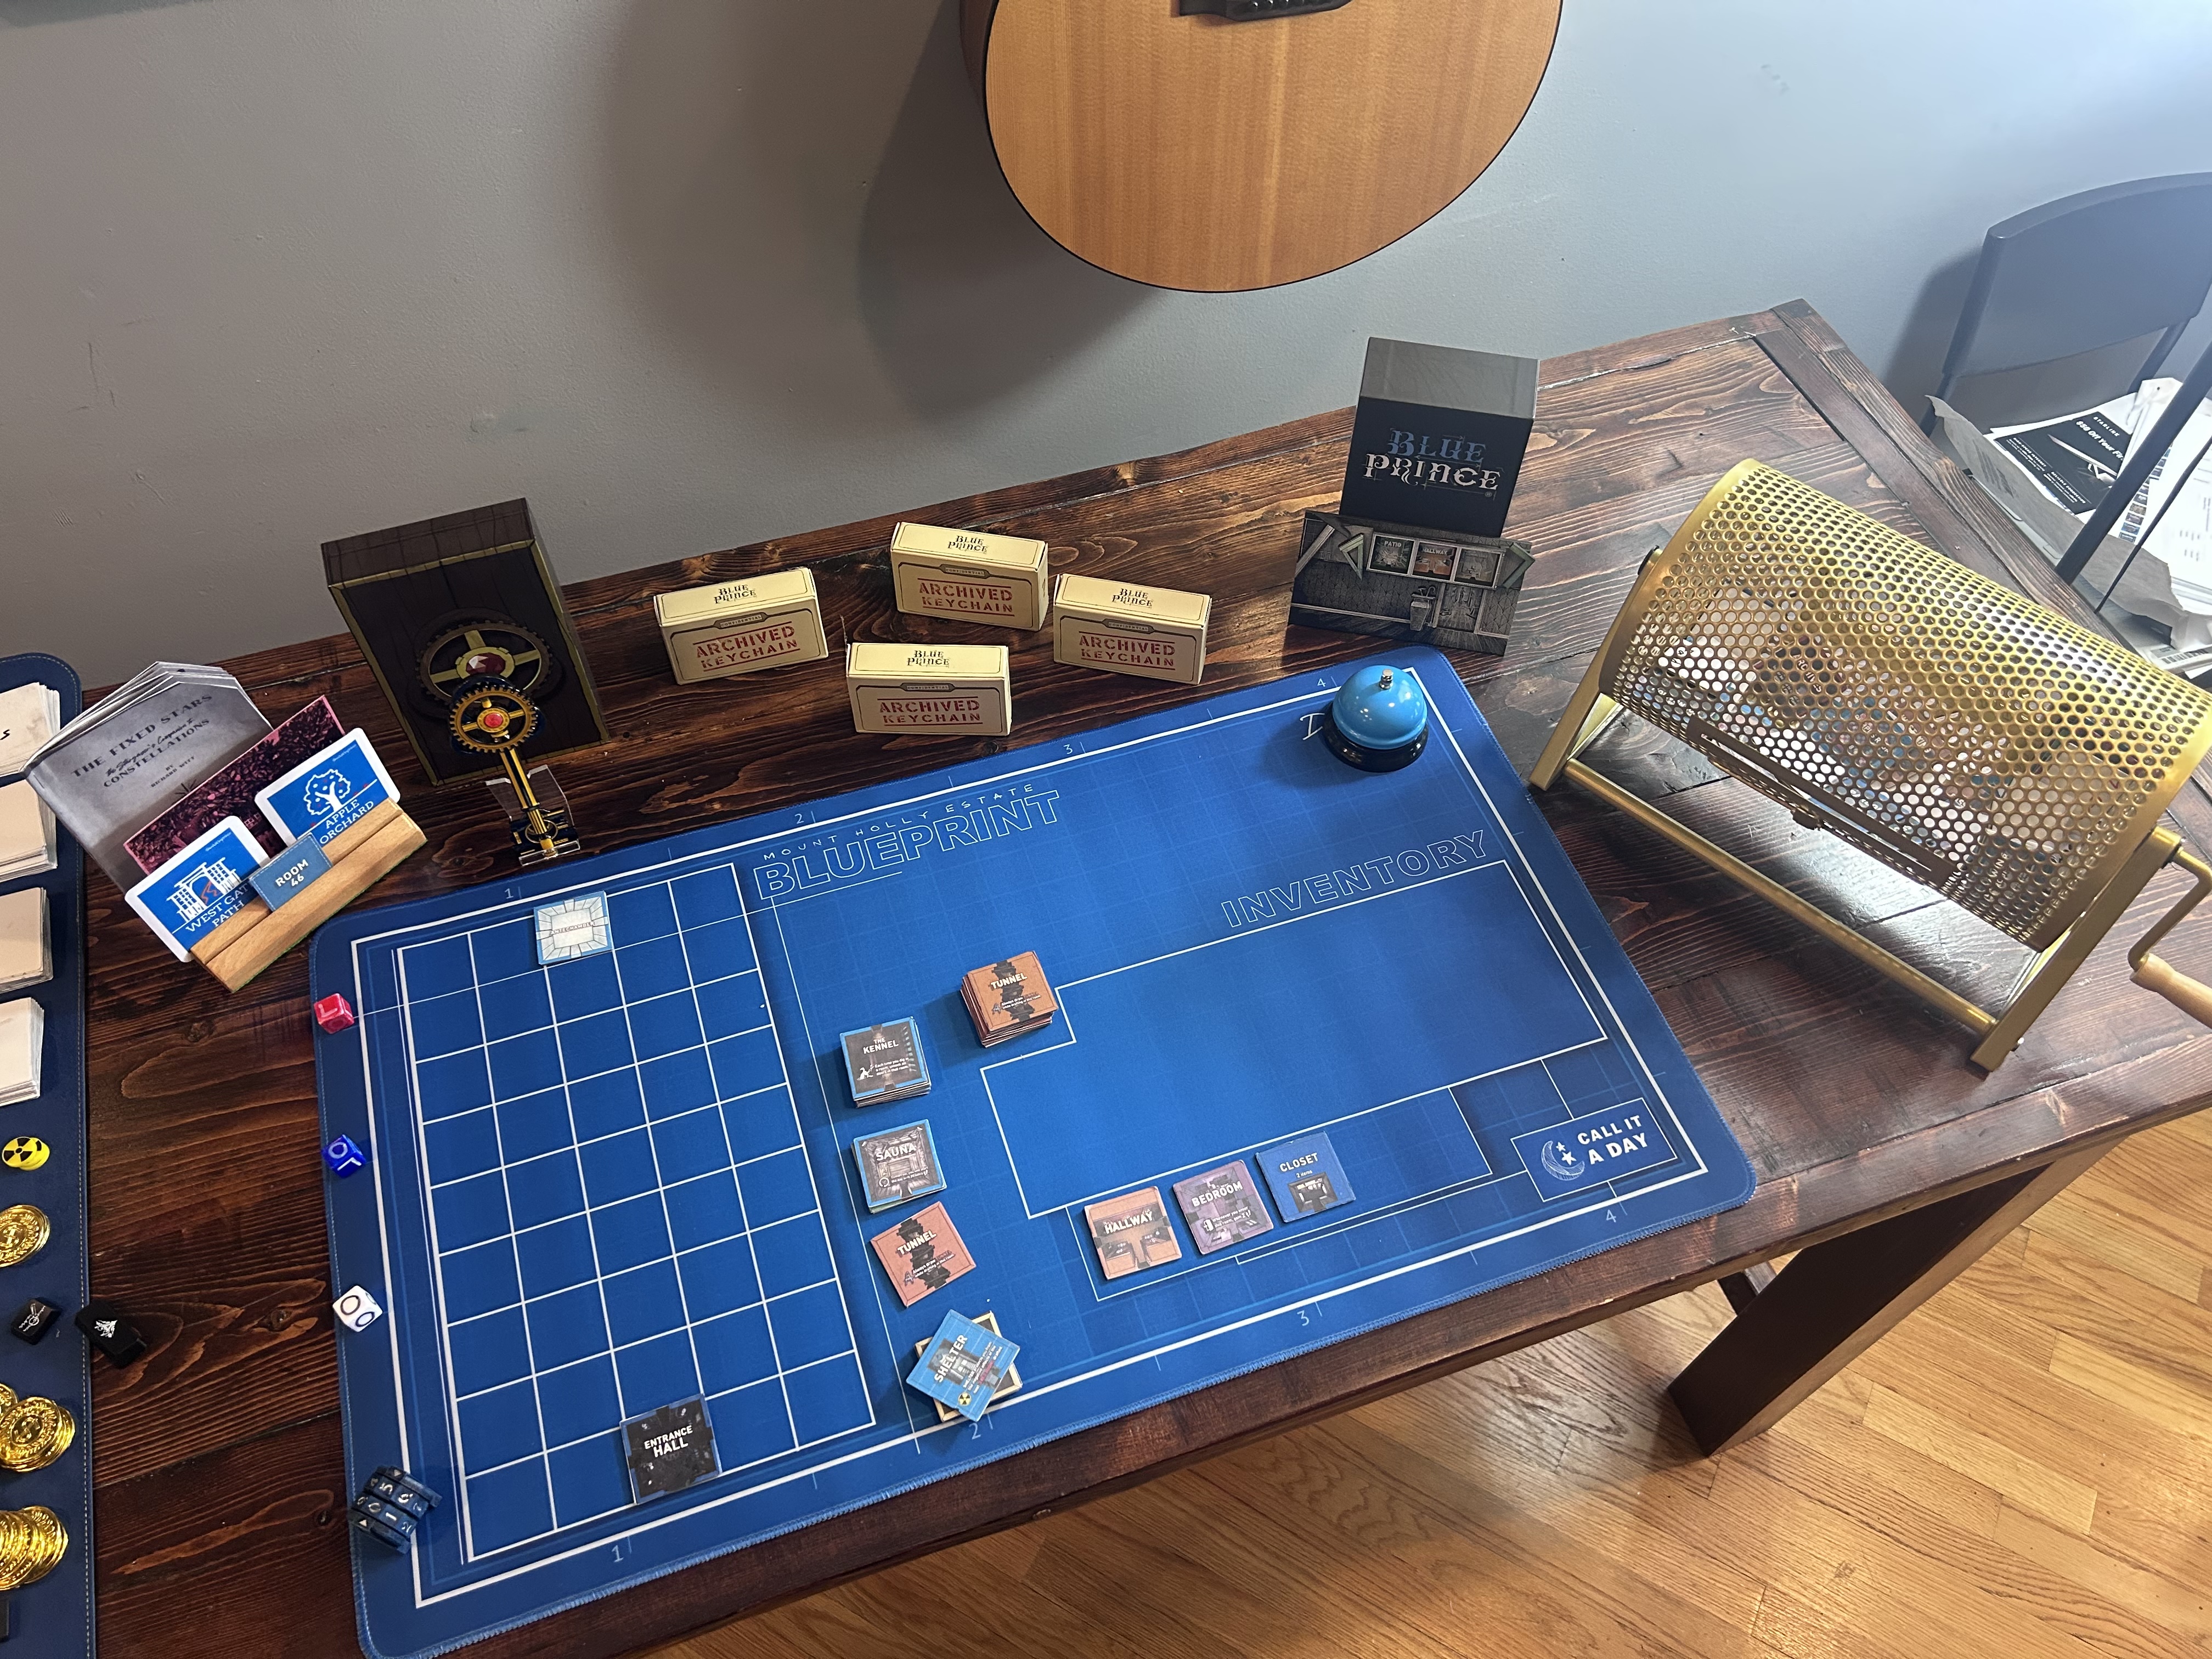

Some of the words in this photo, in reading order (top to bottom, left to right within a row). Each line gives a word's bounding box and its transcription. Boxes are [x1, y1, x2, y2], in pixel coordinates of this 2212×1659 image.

[2076, 420, 2091, 431] $50
[1387, 430, 1486, 463] BLUE
[1363, 453, 1500, 490] PRINCE
[947, 541, 988, 554] PRINCE
[955, 535, 984, 545] BLUE
[714, 590, 757, 603] PRINCE
[719, 584, 748, 595] BLUE
[919, 582, 1012, 601] ARCHIVED
[1119, 587, 1148, 599] BLUE
[922, 596, 1012, 612] KEYCHAIN
[1112, 595, 1153, 607] PRINCE
[721, 616, 761, 627] CONFIDENTIAL
[1109, 622, 1148, 631] CONFIDENTIAL
[697, 626, 795, 658] ARCHIVED
[1079, 635, 1175, 656] ARCHIVED
[701, 639, 797, 668] KEYCHAIN
[907, 658, 950, 667] PRINCE
[1081, 648, 1174, 667] KEYCHAIN
[1317, 678, 1327, 687] 4
[880, 699, 980, 713] ARCHIVED
[883, 713, 980, 723] KEYCHAIN
[72, 756, 105, 777] THE
[110, 724, 156, 756] FIXED
[161, 695, 212, 724] STARS
[103, 719, 210, 788] CONSTELLATIONS
[1063, 743, 1073, 755] 3
[319, 801, 374, 844] ORCHARD
[325, 799, 359, 829] APPLE
[763, 834, 837, 860] MOUNT
[855, 810, 929, 837] HOLLY
[945, 783, 1035, 813] ESTATE
[795, 812, 804, 825] 2
[753, 789, 1060, 900] BLUEPRINT
[275, 859, 309, 887] ROOM
[291, 875, 304, 887] 46
[1221, 830, 1486, 928] INVENTORY
[504, 888, 514, 900] 1
[185, 902, 222, 932] WEST
[224, 883, 251, 905] GAT
[212, 900, 245, 927] PATH
[551, 921, 595, 935] ANTECHAMBER
[990, 973, 1028, 989] TUNNEL
[863, 1040, 899, 1054] KENNEL
[1578, 1122, 1622, 1145] CALL
[1624, 1115, 1642, 1130] IT
[876, 1143, 917, 1161] SAUNA
[1588, 1149, 1604, 1165] A
[1606, 1132, 1648, 1158] DAY
[1279, 1152, 1318, 1172] CLOSET
[1192, 1181, 1243, 1207] BEDROOM
[1104, 1211, 1152, 1234] HALLWAY
[1606, 1209, 1617, 1223] 4
[897, 1230, 937, 1255] TUNNEL
[1297, 1310, 1310, 1327] 3
[934, 1335, 968, 1383] SHELTER
[644, 1425, 693, 1449] ENTRANCE
[969, 1423, 981, 1439] 2
[653, 1437, 689, 1458] HALL
[611, 1545, 623, 1562] 1
